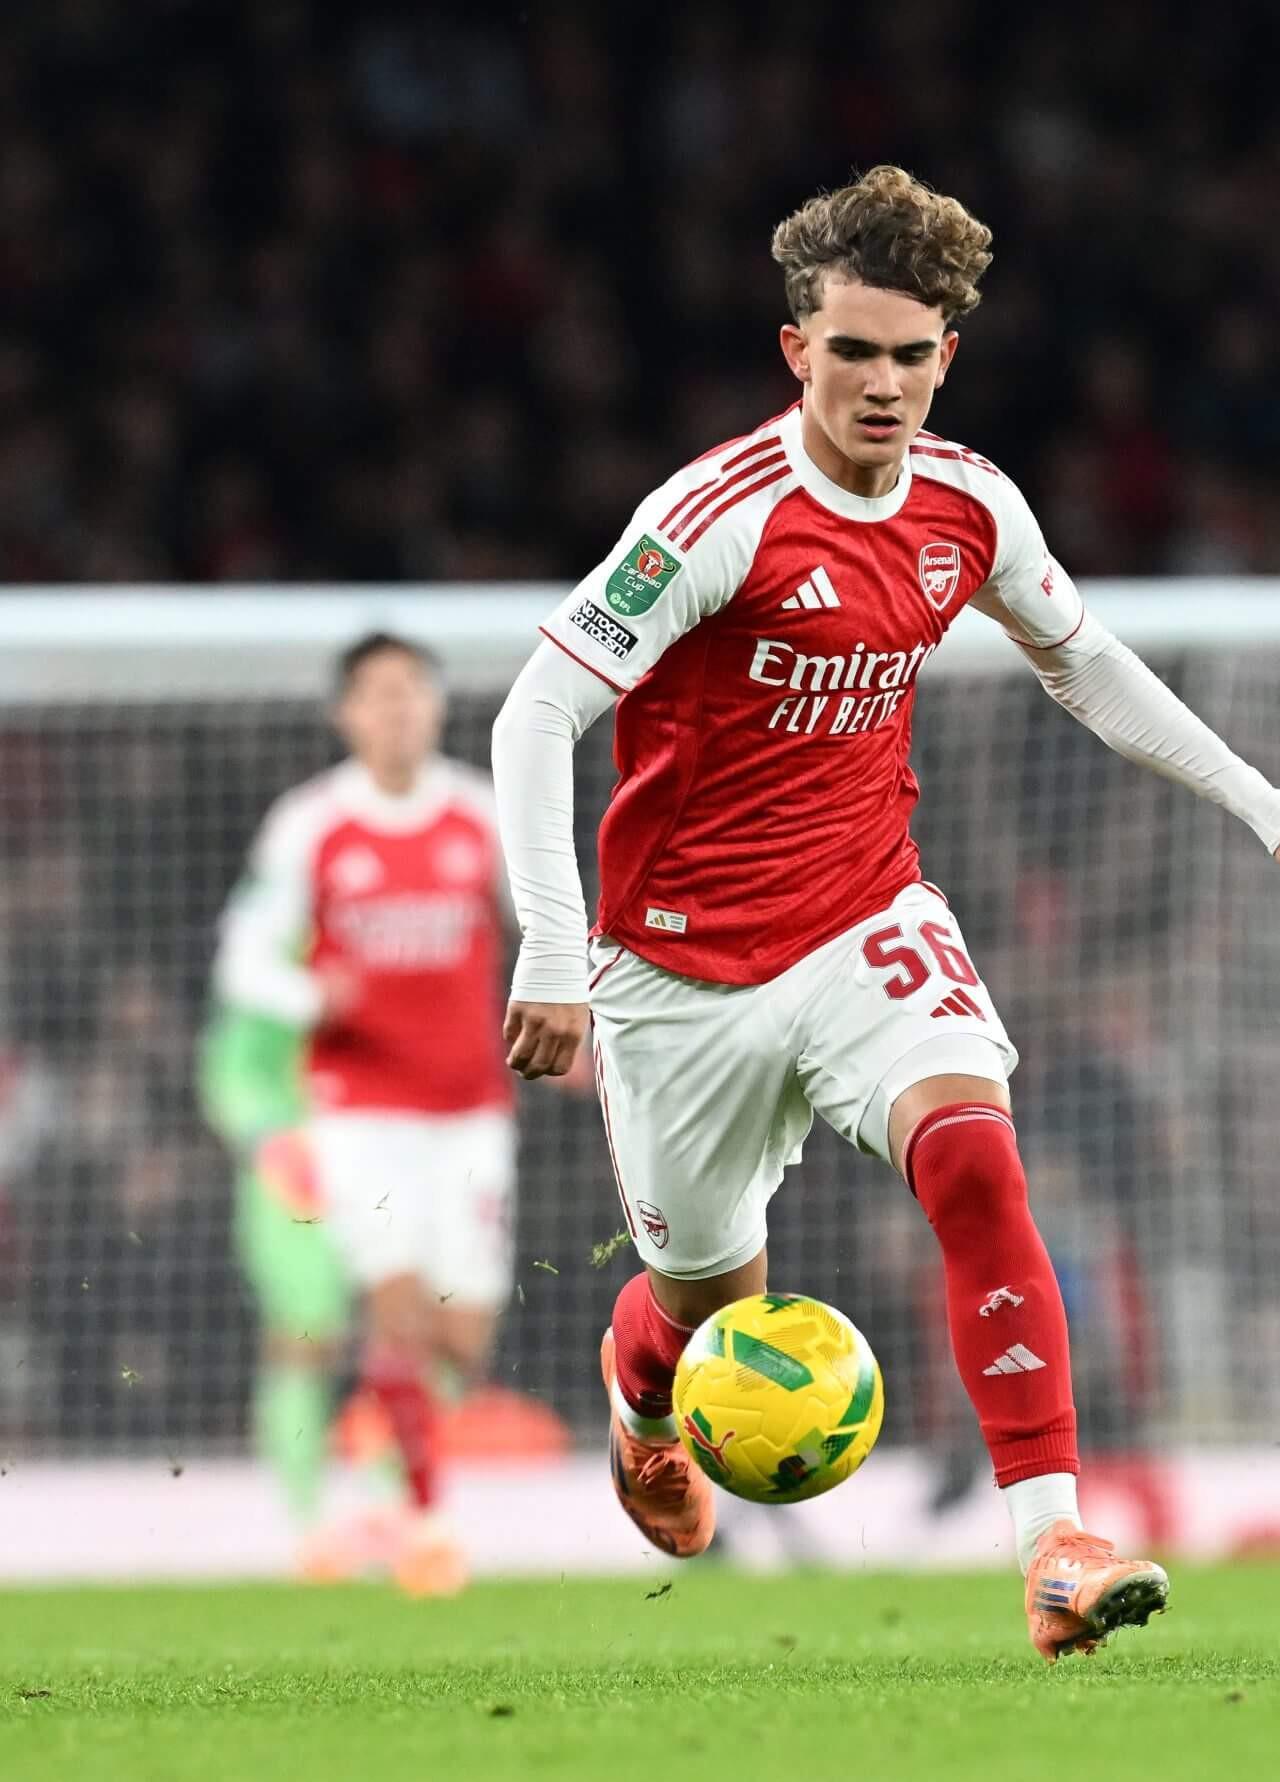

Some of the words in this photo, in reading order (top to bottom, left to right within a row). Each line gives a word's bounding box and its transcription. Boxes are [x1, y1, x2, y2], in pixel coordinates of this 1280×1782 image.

[621, 562, 662, 589] Carabao
[925, 554, 954, 566] Arsenal
[624, 576, 645, 592] Cup
[585, 620, 628, 660] racism
[593, 614, 630, 646] room
[748, 637, 937, 692] Emirat
[767, 696, 829, 735] FLY
[828, 689, 906, 735] BETTE
[861, 920, 980, 1001] 56
